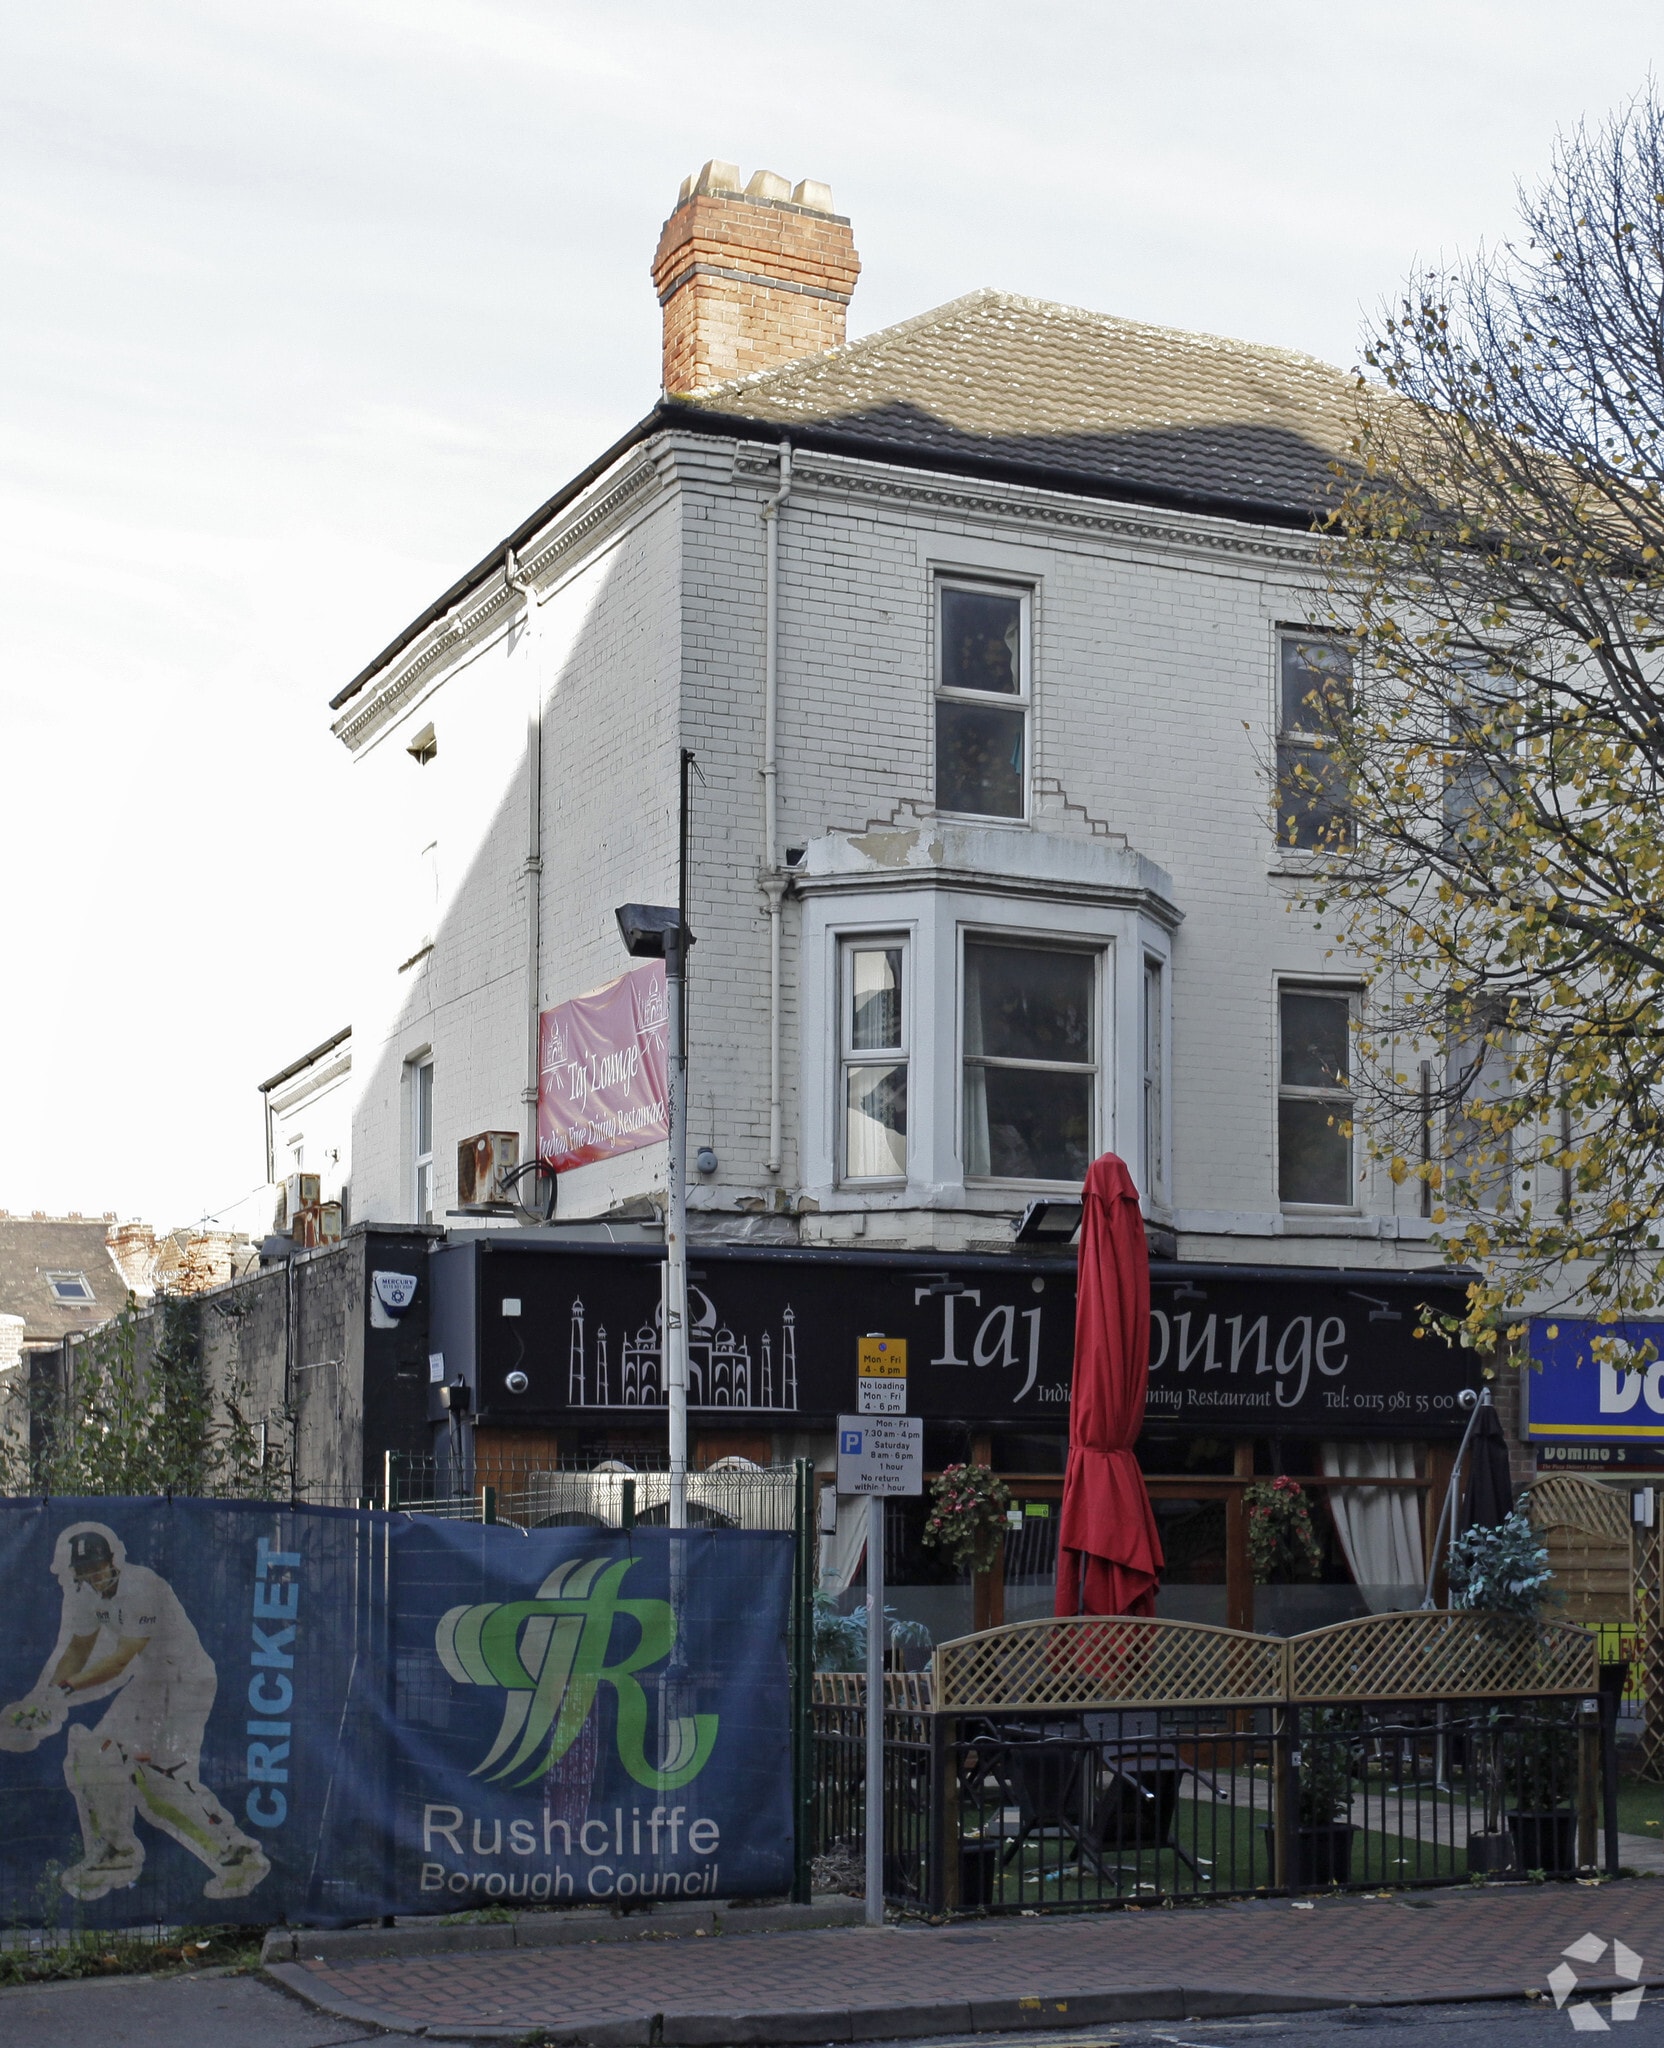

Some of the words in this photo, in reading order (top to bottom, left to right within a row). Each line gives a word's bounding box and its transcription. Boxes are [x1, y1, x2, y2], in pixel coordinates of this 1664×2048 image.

[567, 1050, 588, 1113] Taj
[591, 1045, 639, 1097] Lounge
[540, 1128, 568, 1159] Indian
[569, 1122, 587, 1151] Fine
[588, 1112, 617, 1149] Dining
[915, 1288, 1041, 1403] Taj
[1148, 1310, 1348, 1408] ounge
[864, 1355, 882, 1363] Mon
[890, 1356, 902, 1364] Fri
[865, 1365, 871, 1373] 4
[880, 1366, 885, 1374] 6
[874, 1382, 905, 1391] loading
[864, 1392, 882, 1400] Mon
[1145, 1384, 1183, 1410] ining
[1187, 1388, 1271, 1407] Restaurant
[1323, 1385, 1349, 1408] Tel:
[1354, 1394, 1384, 1412] 0115
[1389, 1391, 1411, 1412] 981
[1416, 1395, 1429, 1412] 55
[1433, 1395, 1454, 1409] 00
[880, 1403, 885, 1411] 6
[876, 1420, 893, 1428] Mon
[846, 1433, 860, 1453] P
[874, 1441, 911, 1450] Saturday
[870, 1451, 876, 1459] 8
[885, 1463, 904, 1471] hour
[246, 1537, 301, 1829] CRICKET
[423, 1804, 720, 1856] Rushcliffe
[419, 1862, 574, 1901] Borough
[587, 1863, 719, 1897] Council
